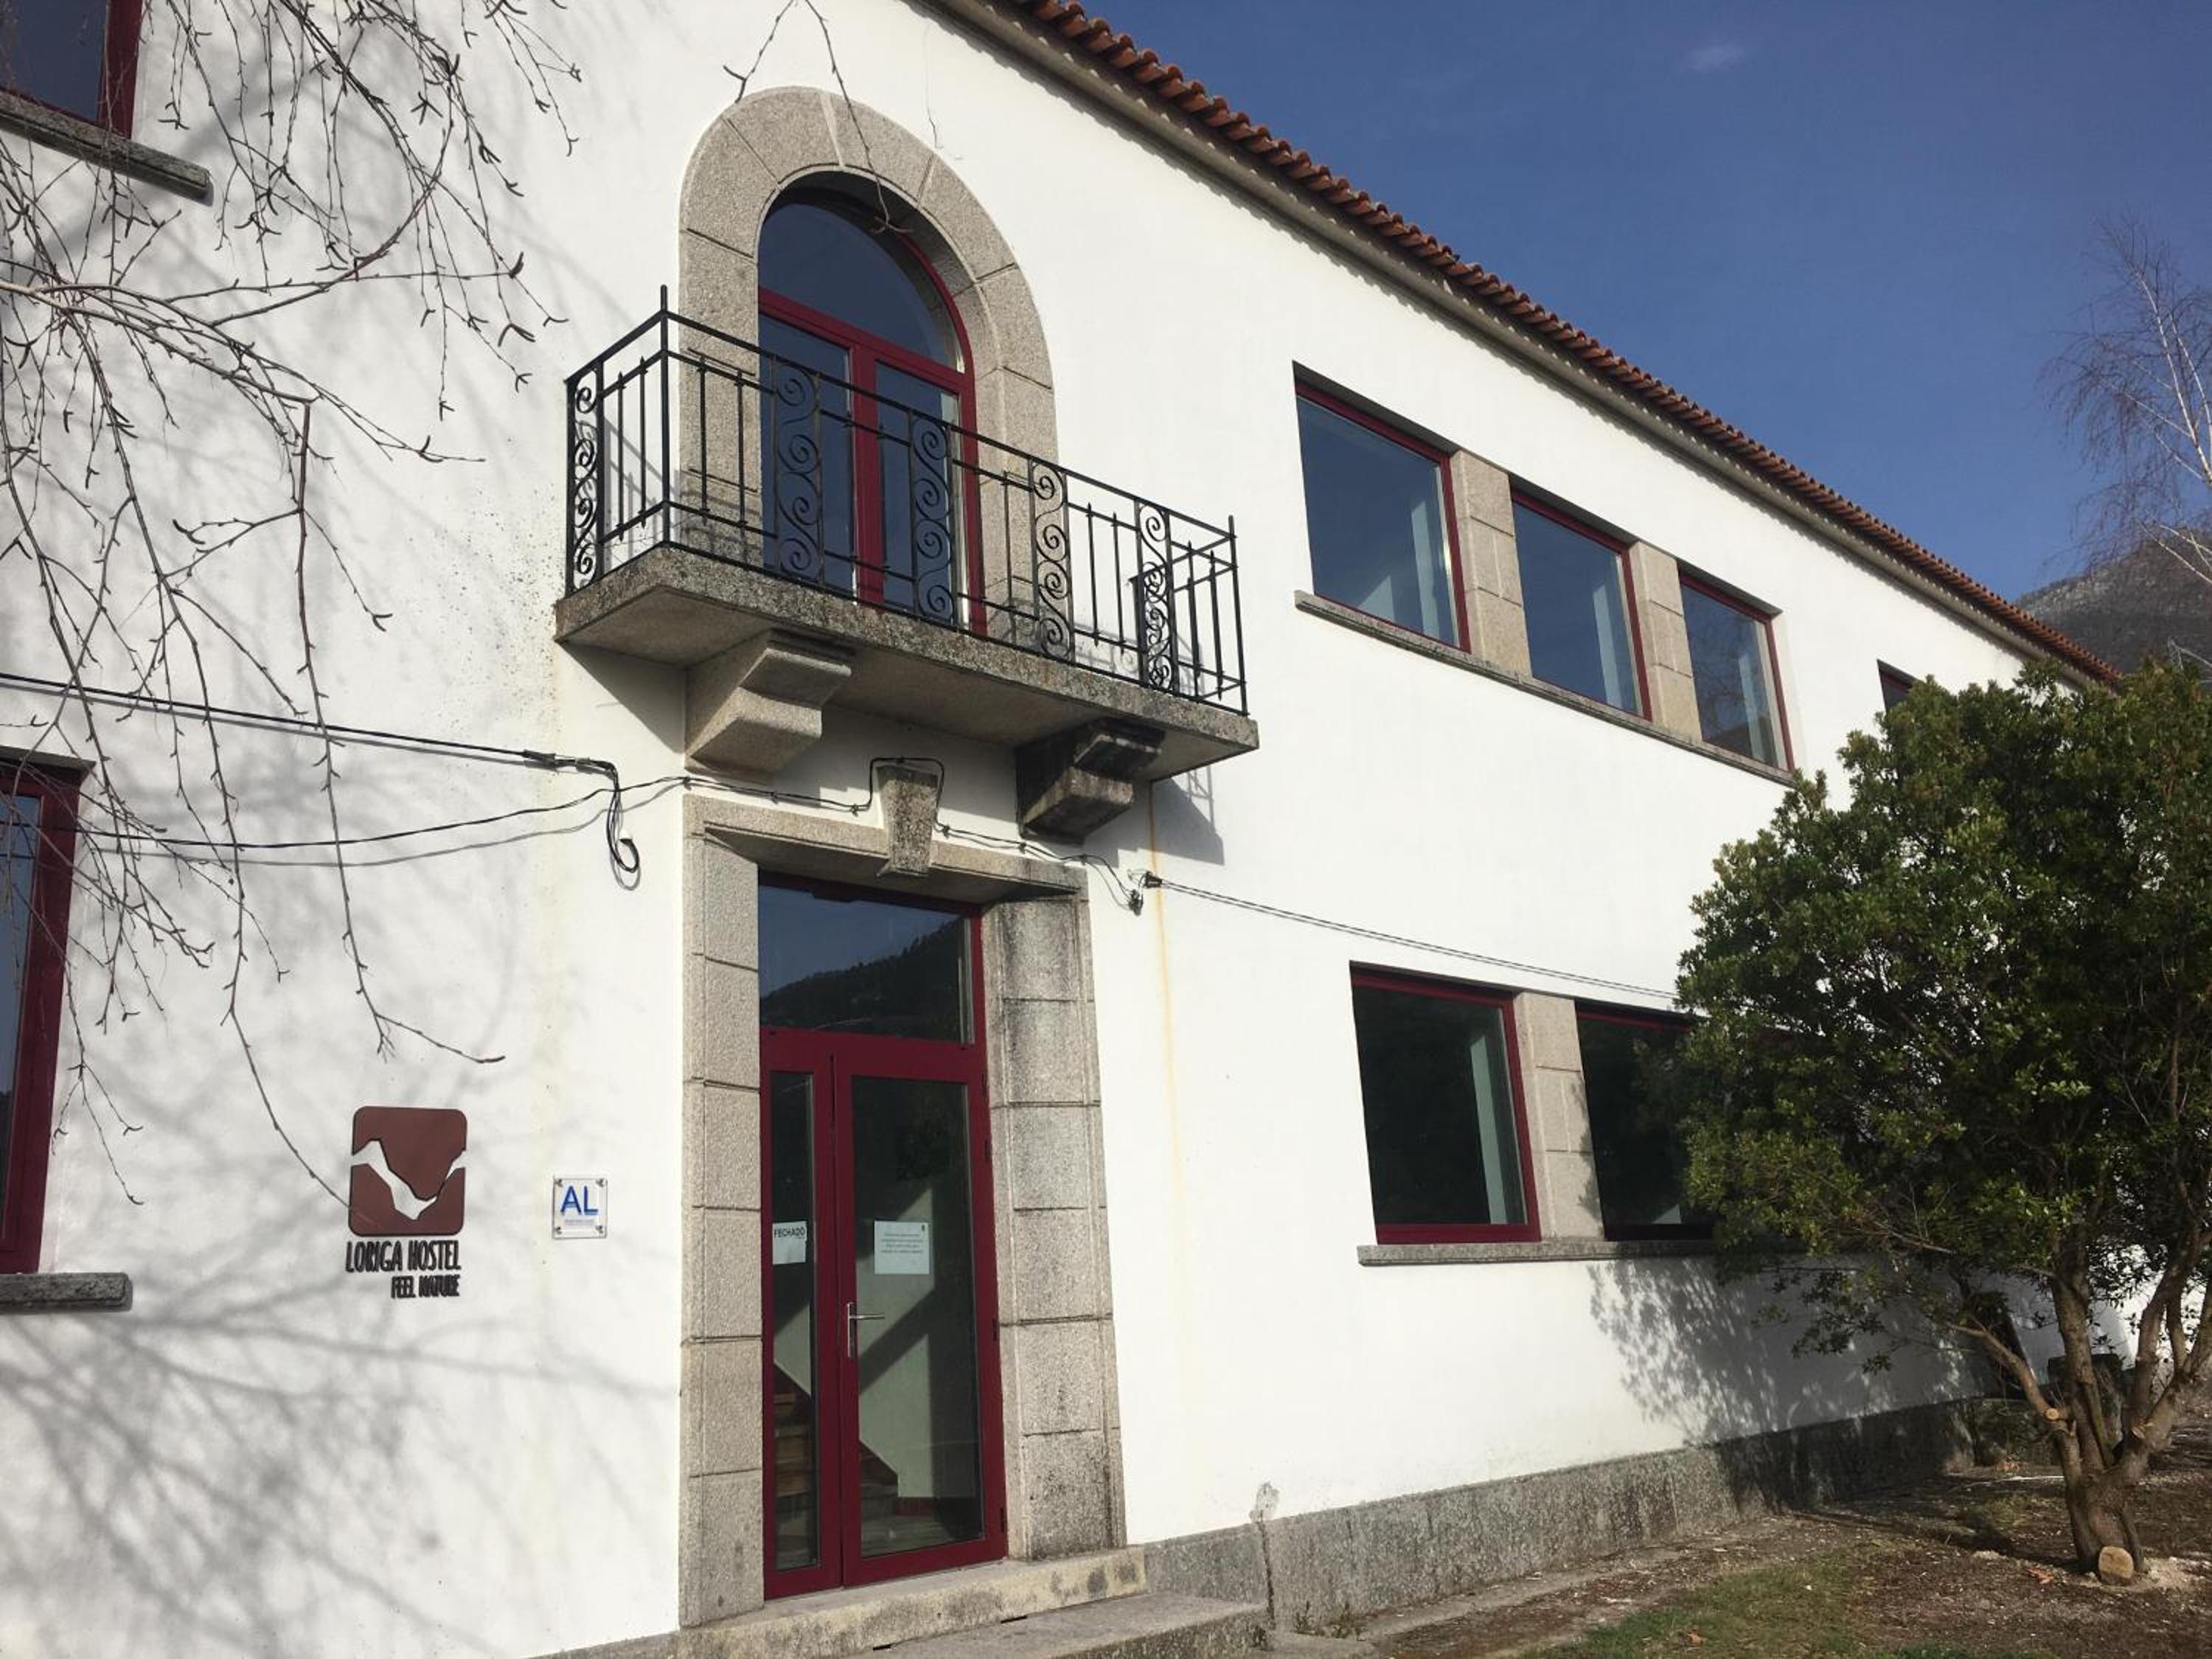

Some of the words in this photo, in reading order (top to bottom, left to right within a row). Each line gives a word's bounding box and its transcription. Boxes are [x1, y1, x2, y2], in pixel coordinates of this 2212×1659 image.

[560, 1185, 599, 1215] AL
[773, 1226, 805, 1238] FECHADO
[345, 1240, 403, 1273] LORIGA
[408, 1239, 462, 1271] HOSTEL
[391, 1275, 416, 1298] FEEL
[418, 1274, 460, 1298] NATURE
